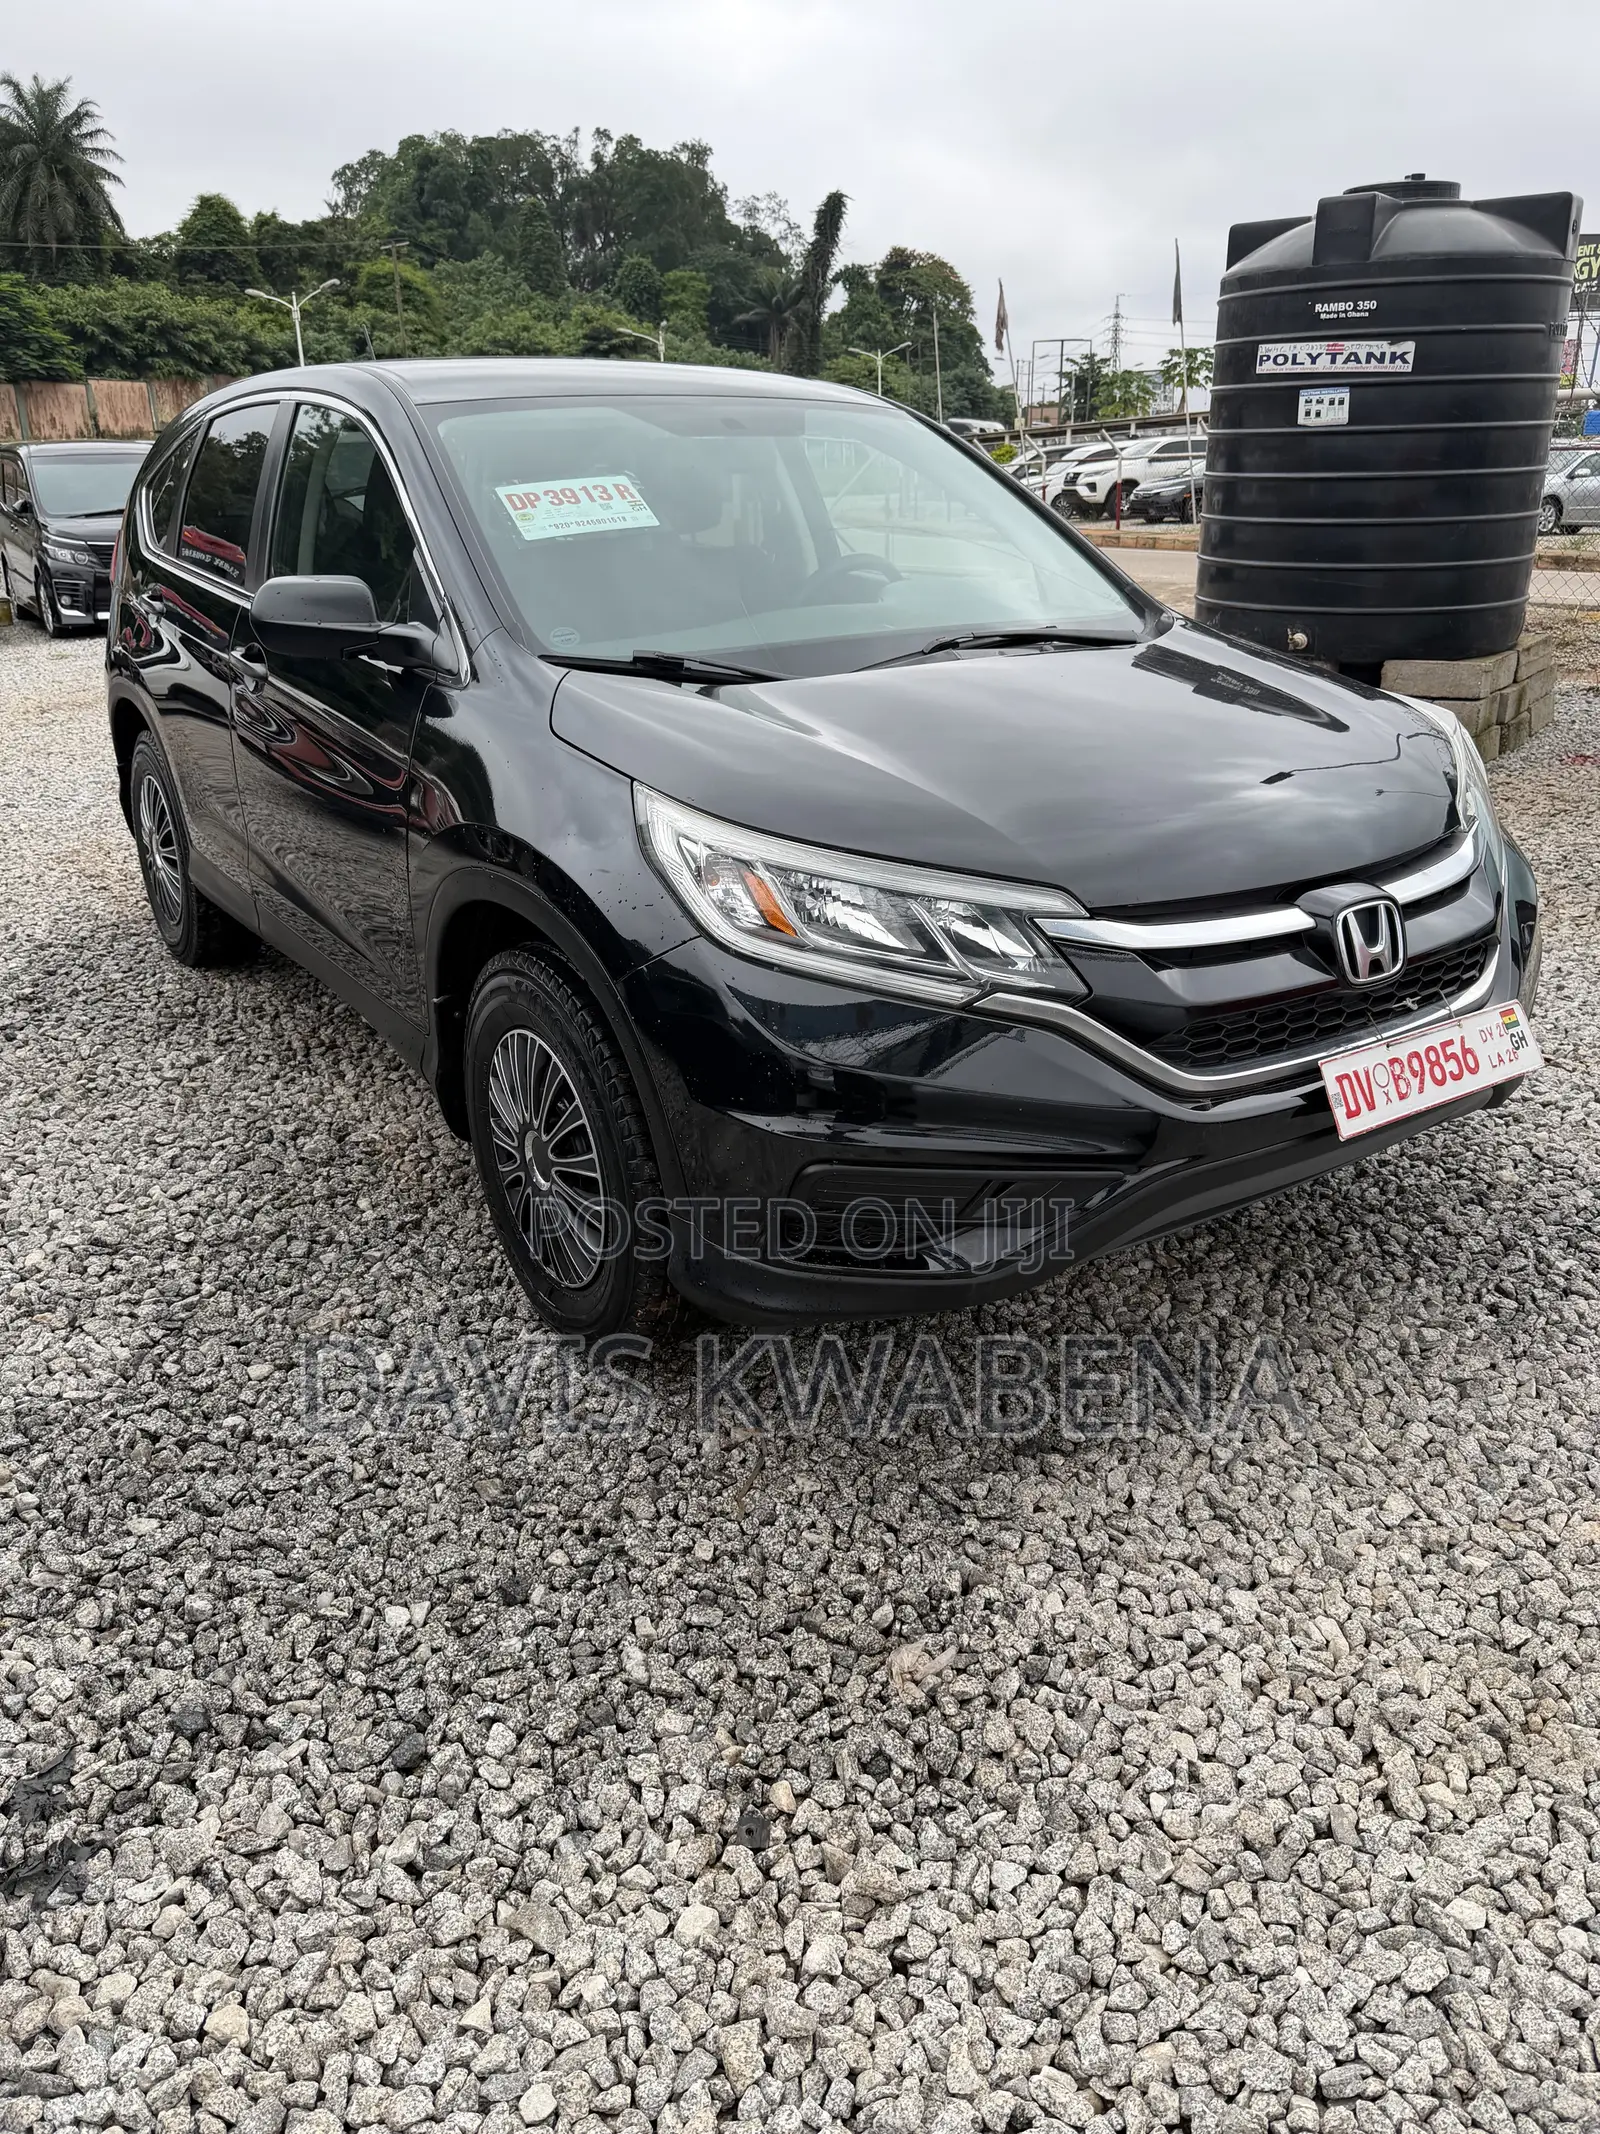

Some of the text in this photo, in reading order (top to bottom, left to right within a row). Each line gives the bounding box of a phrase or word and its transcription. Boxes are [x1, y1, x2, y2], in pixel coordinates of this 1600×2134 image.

[1314, 300, 1378, 313] RAMBO 350
[1319, 312, 1338, 320] Made
[1257, 351, 1412, 367] POLYTANK
[504, 483, 637, 512] DP 3913 R
[1509, 1029, 1529, 1051] GH
[1488, 1052, 1506, 1069] LA
[1335, 1065, 1376, 1120] DV
[1387, 1035, 1480, 1101] B9856
